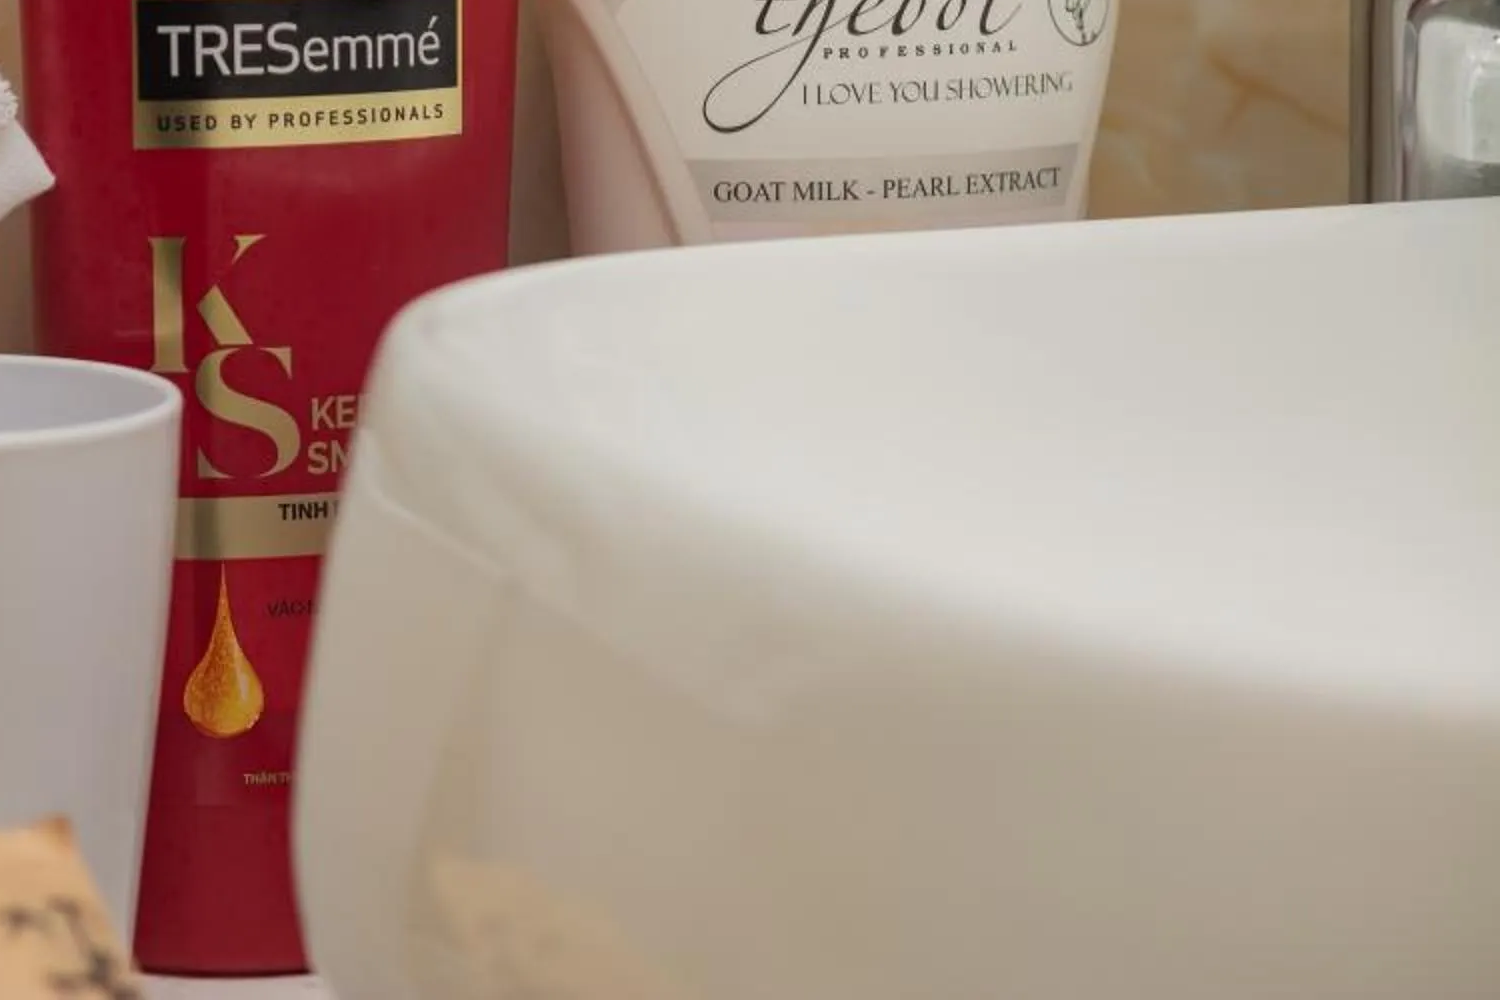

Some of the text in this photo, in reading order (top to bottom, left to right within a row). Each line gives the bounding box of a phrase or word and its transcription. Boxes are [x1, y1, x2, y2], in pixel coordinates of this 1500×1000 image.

[156, 15, 441, 78] TRESemmé
[823, 41, 1017, 59] PROFESSIONAL
[816, 82, 880, 105] LOVE
[889, 80, 939, 102] YOU
[946, 71, 1073, 101] SHOWERING
[157, 104, 444, 132] USED BY PROFESSIONALS
[713, 181, 786, 203] GOAT
[793, 179, 859, 202] MILK
[882, 176, 960, 200] PEARL
[966, 166, 1061, 195] EXTRACT
[148, 234, 268, 373] K
[195, 346, 301, 479] S
[311, 395, 360, 431] KE
[278, 502, 329, 520] TINH
